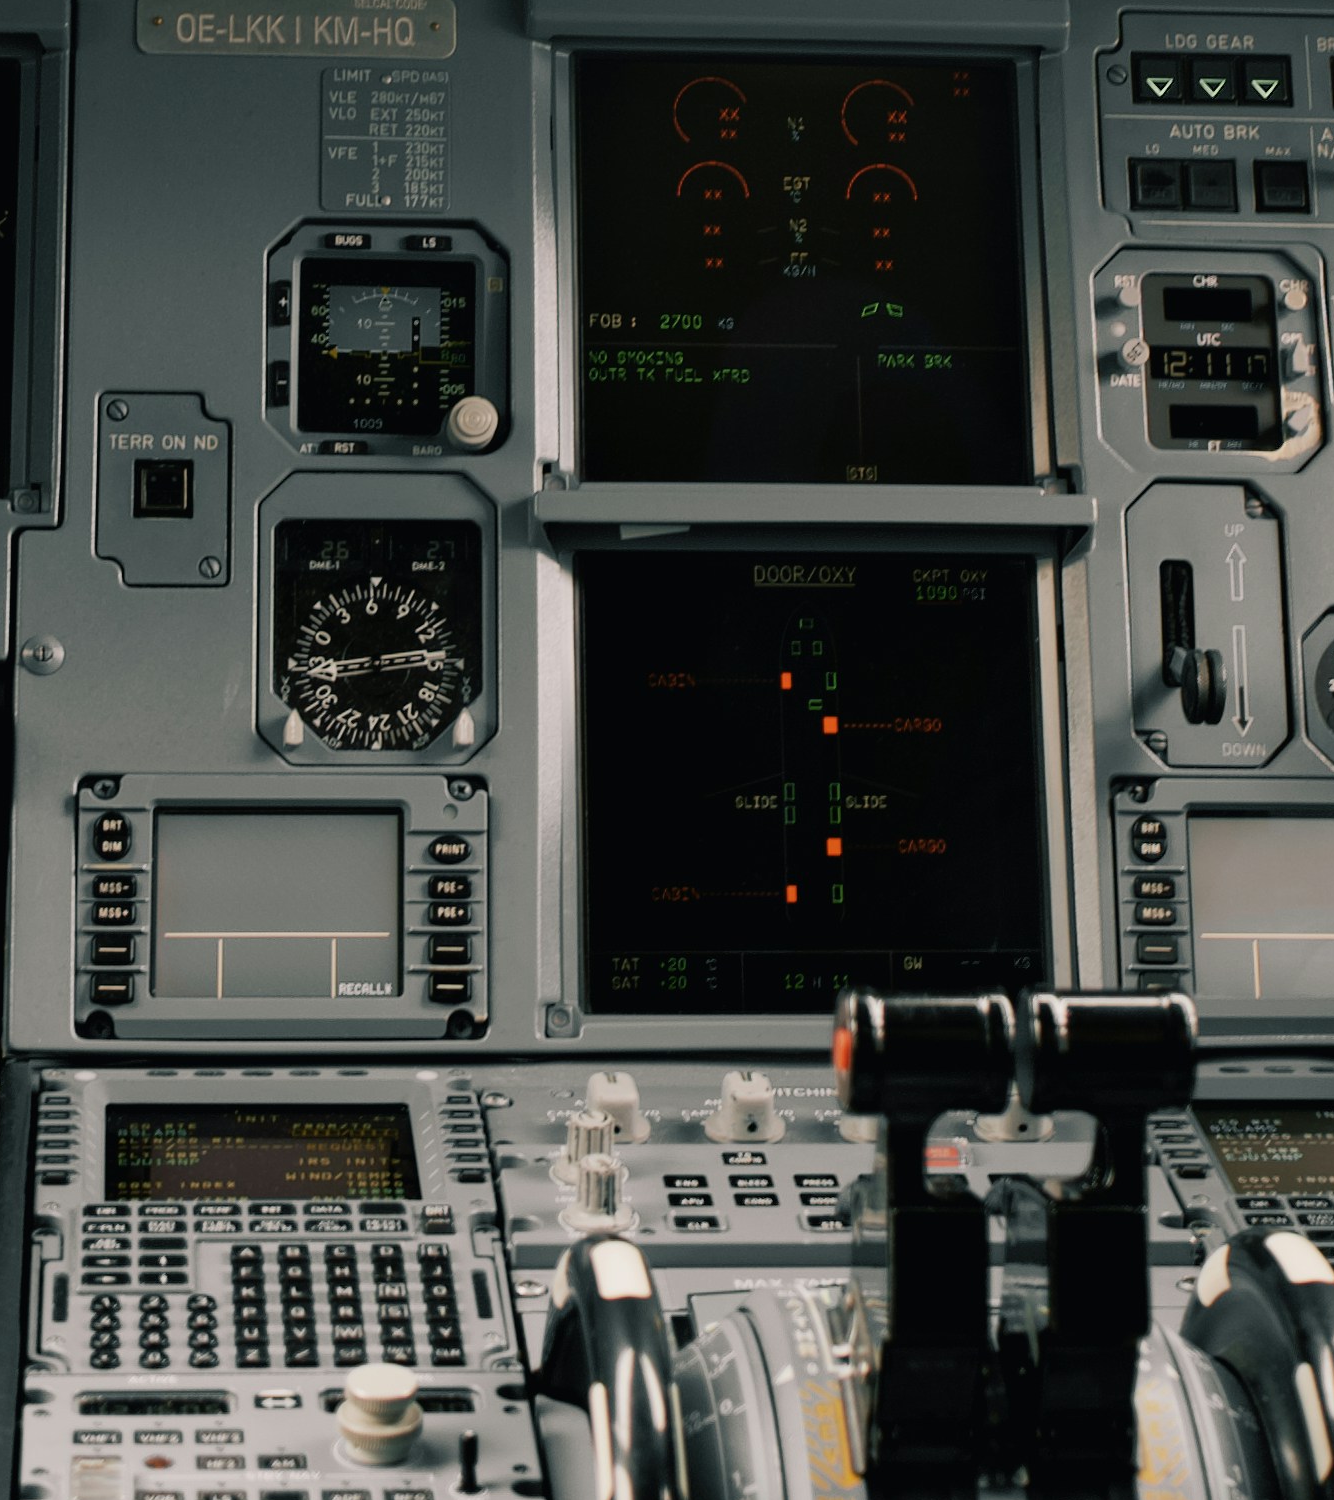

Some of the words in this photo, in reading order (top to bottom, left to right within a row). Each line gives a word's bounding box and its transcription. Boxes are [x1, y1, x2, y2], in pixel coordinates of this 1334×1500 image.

[176, 13, 286, 44] OE-LKK
[314, 16, 416, 46] KM-HQ
[1165, 34, 1198, 50] LDG
[1206, 34, 1255, 50] GEAR
[334, 69, 372, 82] LIMIT
[392, 70, 420, 83] SPD
[422, 71, 449, 84] (IAS)
[329, 91, 356, 104] VLE
[329, 107, 356, 120] VLO
[371, 108, 398, 121] EXT
[405, 109, 445, 122] 250KT
[369, 123, 398, 136] RET
[405, 124, 445, 137] 220KT
[1170, 125, 1215, 140] AUTO
[1223, 125, 1260, 140] BRK
[328, 146, 357, 160] VFE
[373, 142, 378, 153] 1
[405, 142, 445, 155] 230KT
[1192, 145, 1219, 156] MED
[1265, 146, 1291, 156] MAX
[372, 155, 398, 167] 1+F
[405, 155, 445, 168] 215KT
[372, 168, 380, 180] 2
[404, 169, 445, 181] 200KT
[372, 182, 380, 193] 3
[404, 182, 445, 195] 185KT
[346, 194, 381, 207] FULL
[405, 194, 444, 208] 177KT
[589, 314, 622, 328] FOB
[660, 313, 703, 330] 2700
[1197, 333, 1221, 346] UTC
[589, 351, 608, 364] NO
[877, 353, 915, 368] PARK
[589, 368, 627, 382] OUTR
[109, 435, 154, 449] TERR
[161, 435, 185, 450] ON
[194, 436, 218, 450] ND
[334, 442, 355, 453] RST
[1224, 524, 1244, 538] UP
[754, 566, 856, 584] DOOR/OXY
[913, 569, 951, 583] CKPT
[961, 569, 988, 583] OXY
[1222, 743, 1266, 758] DOWN
